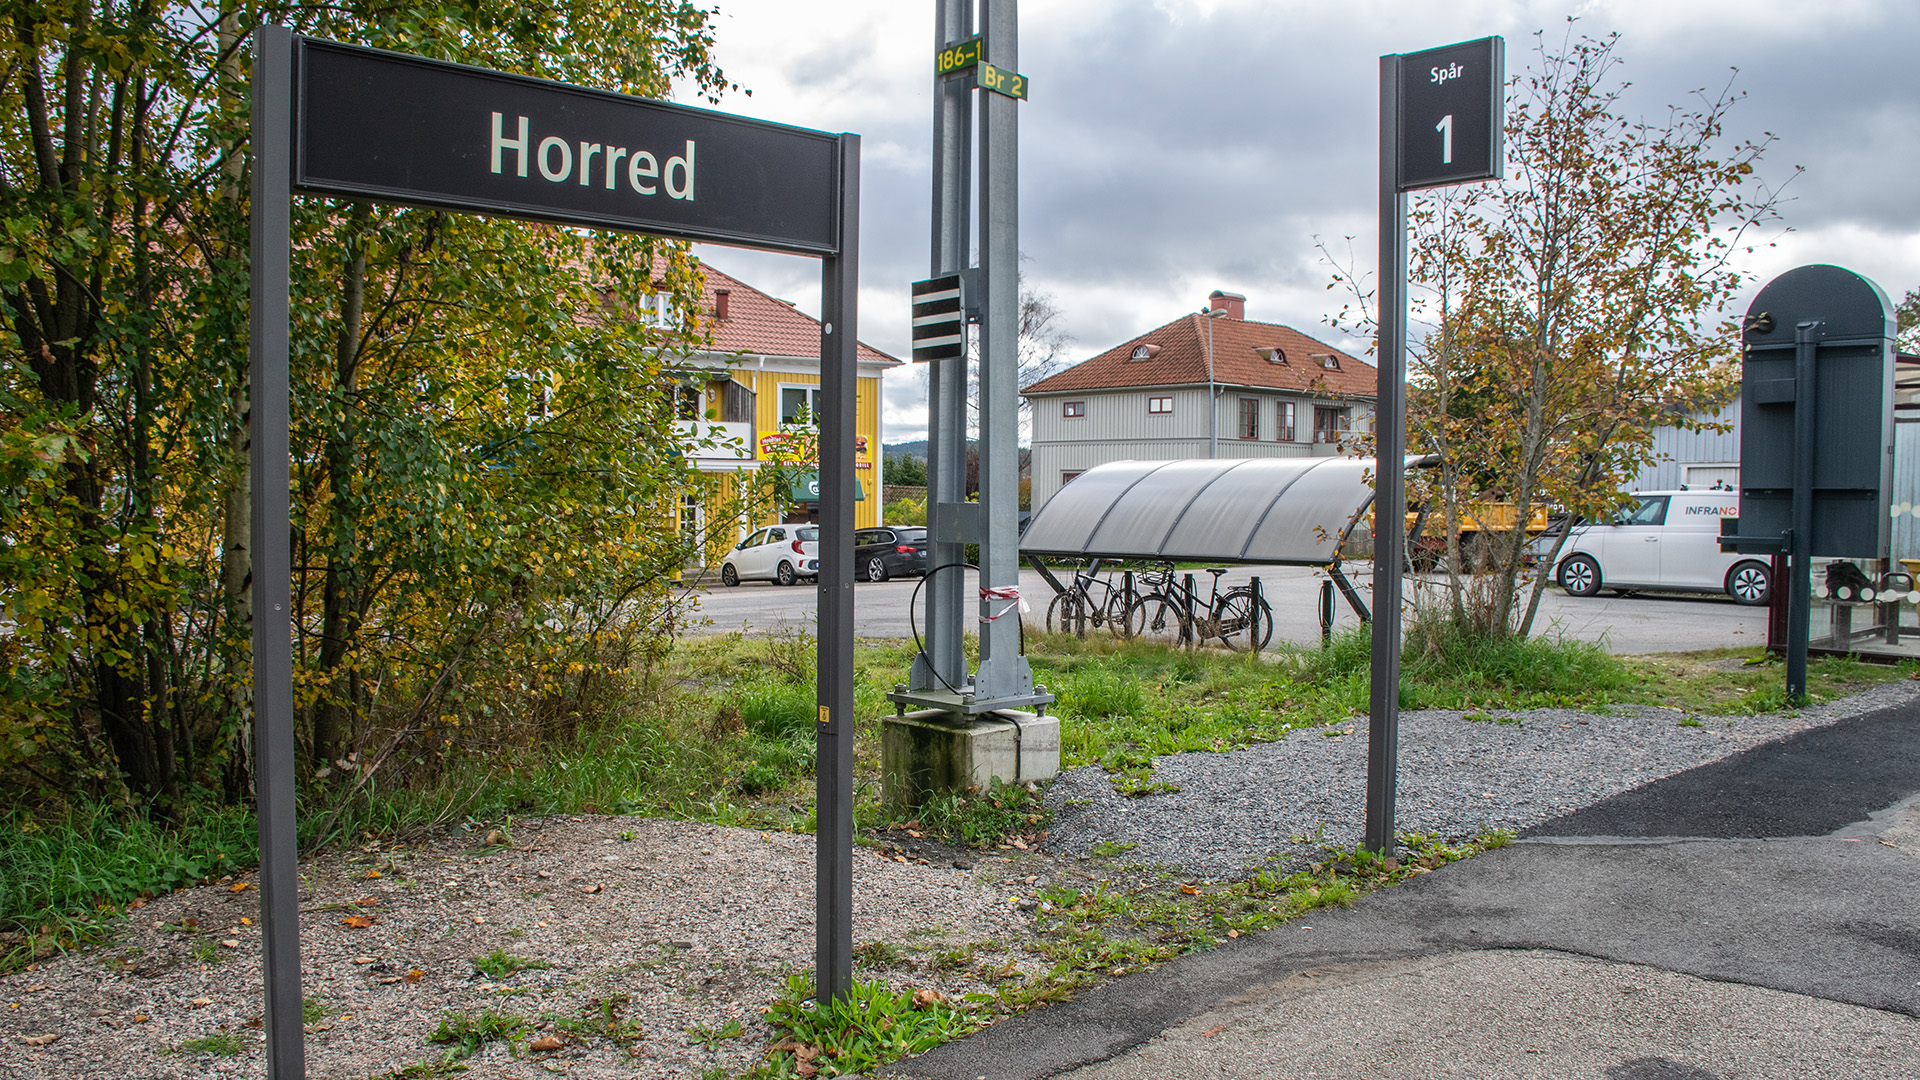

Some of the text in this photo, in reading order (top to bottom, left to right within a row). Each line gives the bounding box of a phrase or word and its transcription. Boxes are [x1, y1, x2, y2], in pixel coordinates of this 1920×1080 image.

[938, 40, 981, 72] 186-1
[985, 65, 1022, 97] Br 2
[1430, 62, 1464, 85] Spår
[1435, 114, 1453, 164] 1
[490, 111, 696, 202] Horred
